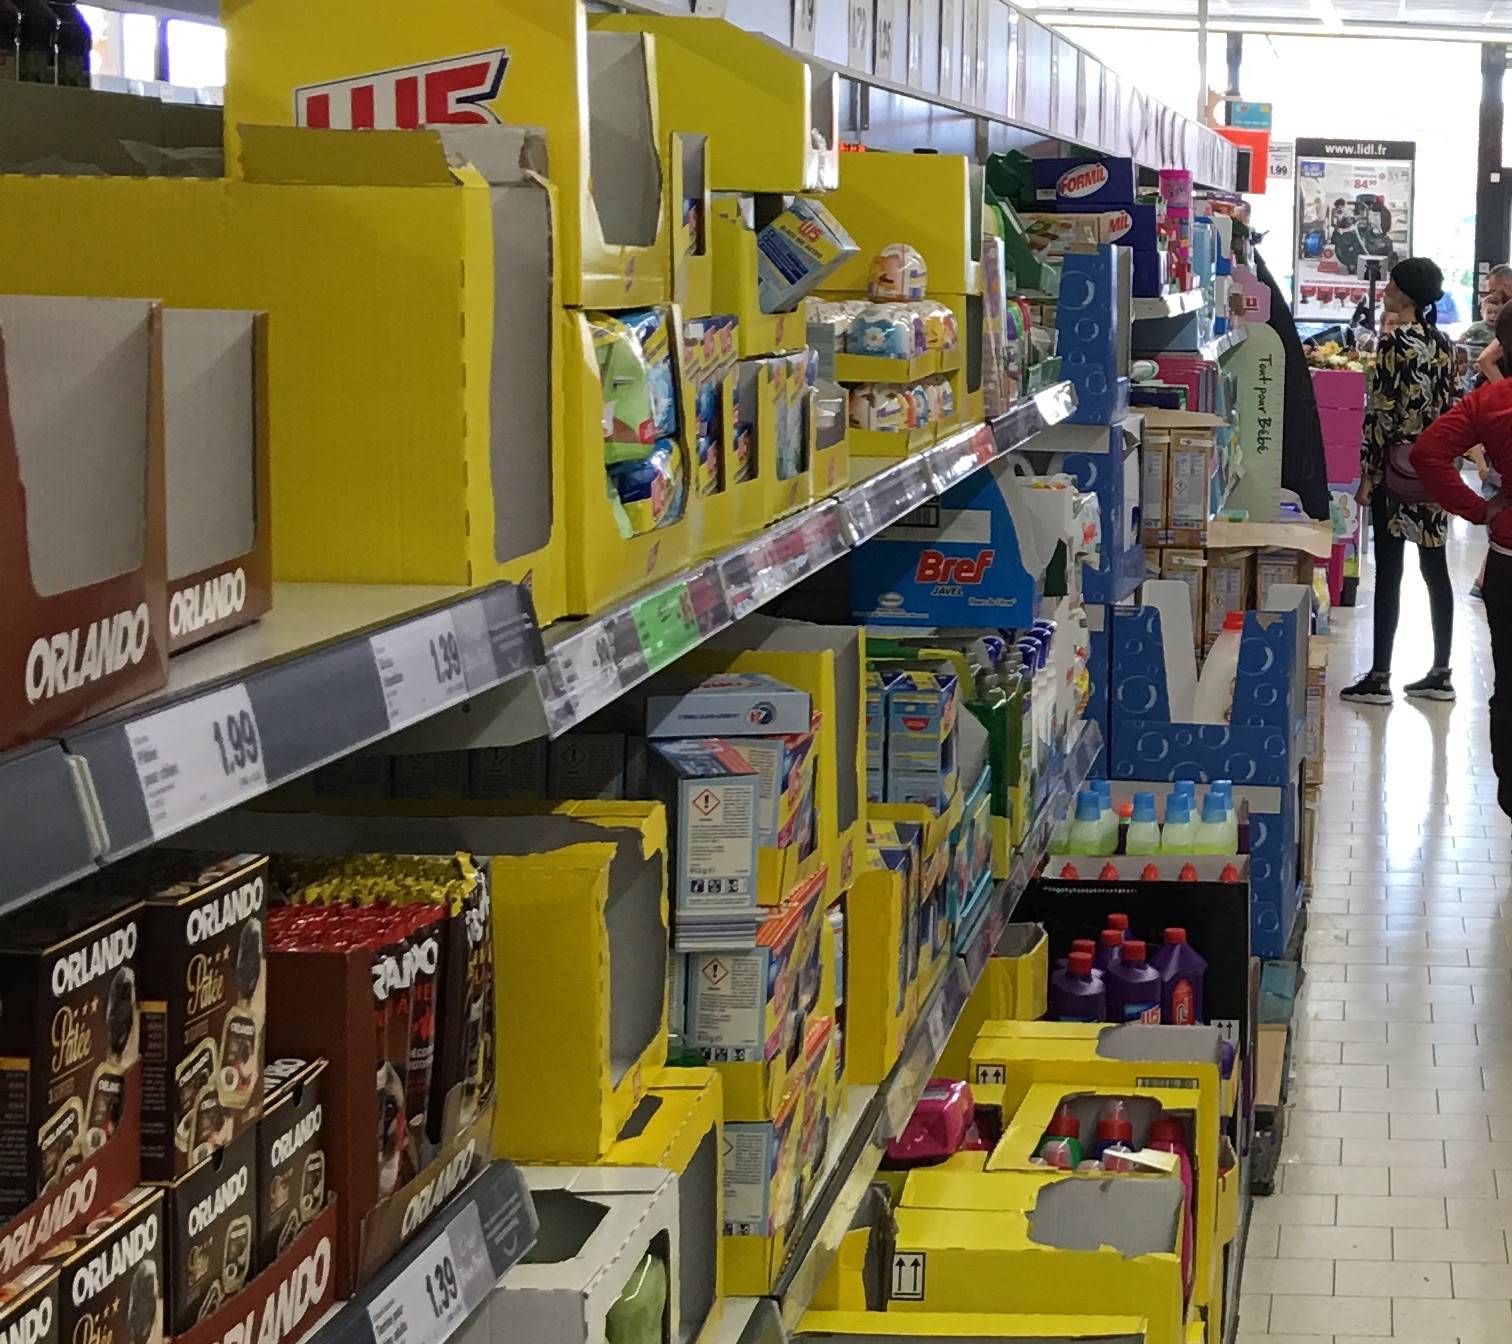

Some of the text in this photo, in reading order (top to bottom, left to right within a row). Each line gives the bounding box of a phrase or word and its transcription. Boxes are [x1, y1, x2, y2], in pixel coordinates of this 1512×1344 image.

[1269, 165, 1288, 176] 1.99
[1324, 143, 1388, 156] www.lidl.fr
[1253, 353, 1273, 455] Tout pour Bébé
[915, 549, 995, 585] Bref
[931, 586, 964, 597] JAVEL
[169, 567, 246, 638] ORLANDO
[25, 603, 150, 706] ORLANDO
[429, 630, 460, 686] 1.39
[213, 709, 259, 776] 1.99
[186, 876, 264, 946] ORLANDO
[52, 921, 138, 997] ORLANDO
[270, 1105, 322, 1168] ORLANDO
[188, 1165, 248, 1237] ORLANDO
[72, 1213, 158, 1307] ORLANDO
[426, 1255, 458, 1319] 1.39
